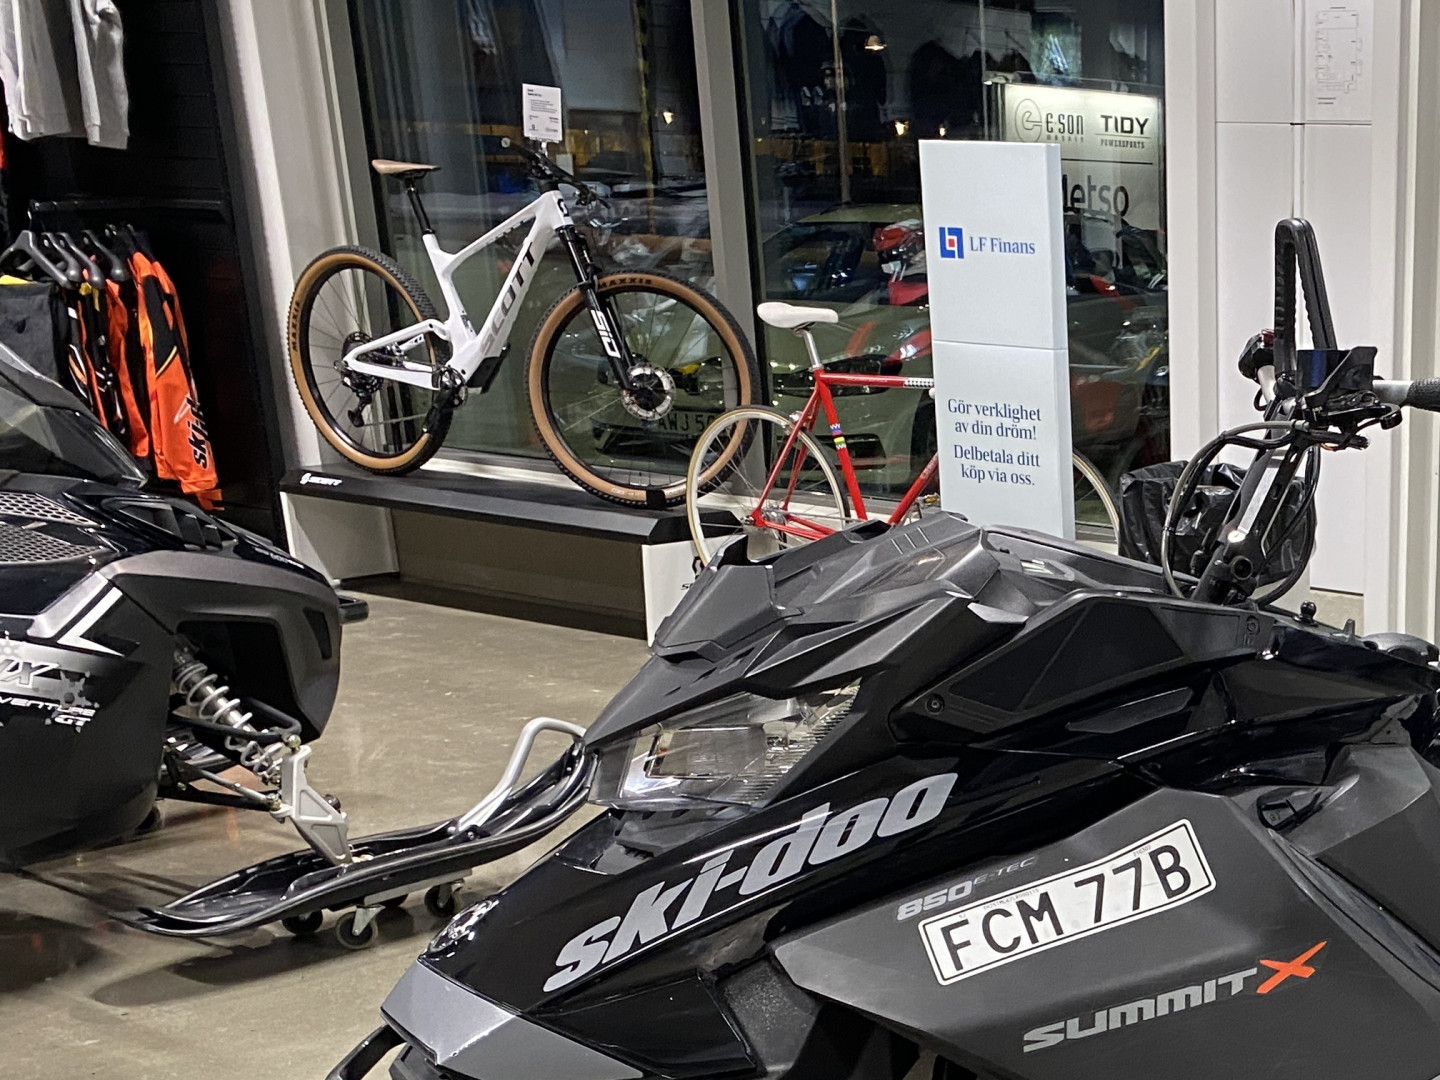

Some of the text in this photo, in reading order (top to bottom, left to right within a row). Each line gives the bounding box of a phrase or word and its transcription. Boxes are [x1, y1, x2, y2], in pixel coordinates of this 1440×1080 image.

[1100, 115, 1150, 135] TIDY
[969, 236, 1036, 255] LF Finans
[479, 241, 535, 356] SCOTT
[591, 309, 622, 359] SID
[947, 398, 1042, 424] Gör verklighet
[954, 420, 1037, 440] av din dröm!
[953, 444, 1040, 467] Delbetala ditt
[960, 463, 1035, 486] köp via oss.
[542, 773, 959, 992] ski-doo
[897, 856, 1036, 921] 850 E-TEC
[940, 844, 1192, 972] FCM 77B
[1023, 940, 1328, 1053] SUMMIT X
